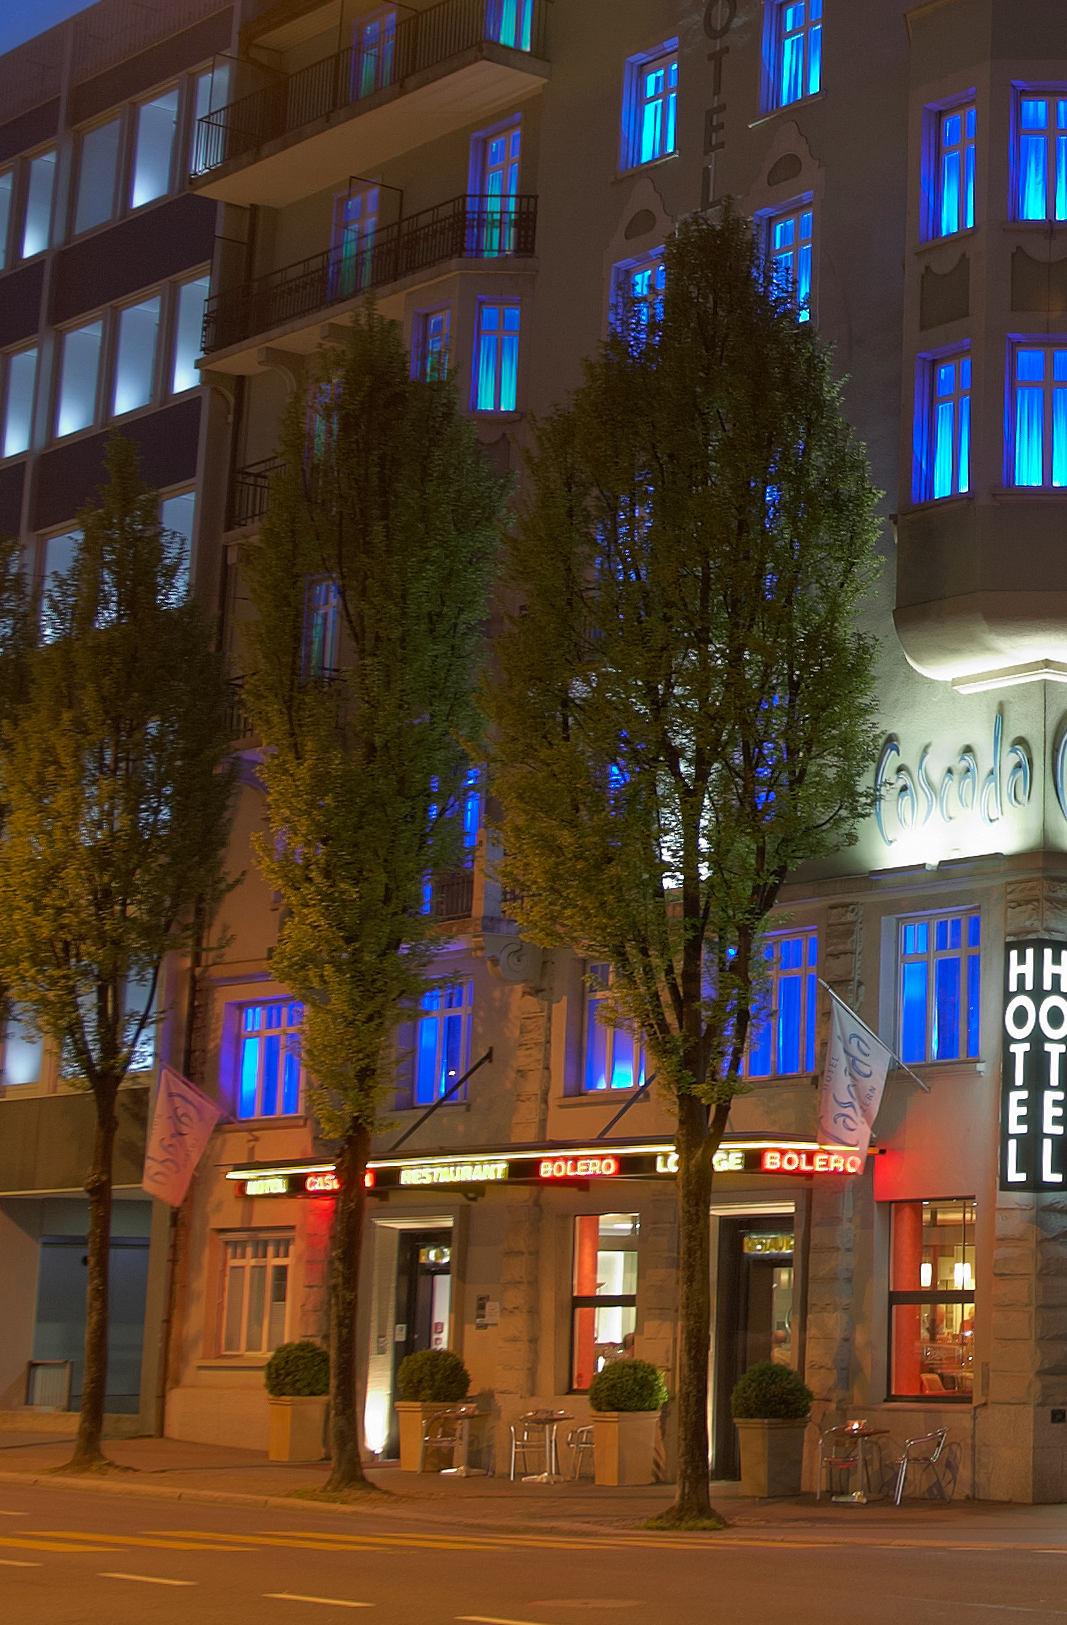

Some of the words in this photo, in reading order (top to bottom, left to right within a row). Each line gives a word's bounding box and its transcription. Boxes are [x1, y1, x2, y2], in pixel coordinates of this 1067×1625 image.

[1004, 947, 1036, 1183] HOTEL
[400, 1163, 508, 1185] RESTAURANT
[540, 1158, 616, 1177] BOLERO
[656, 1152, 744, 1172] LOGE
[765, 1151, 861, 1173] BOLERO
